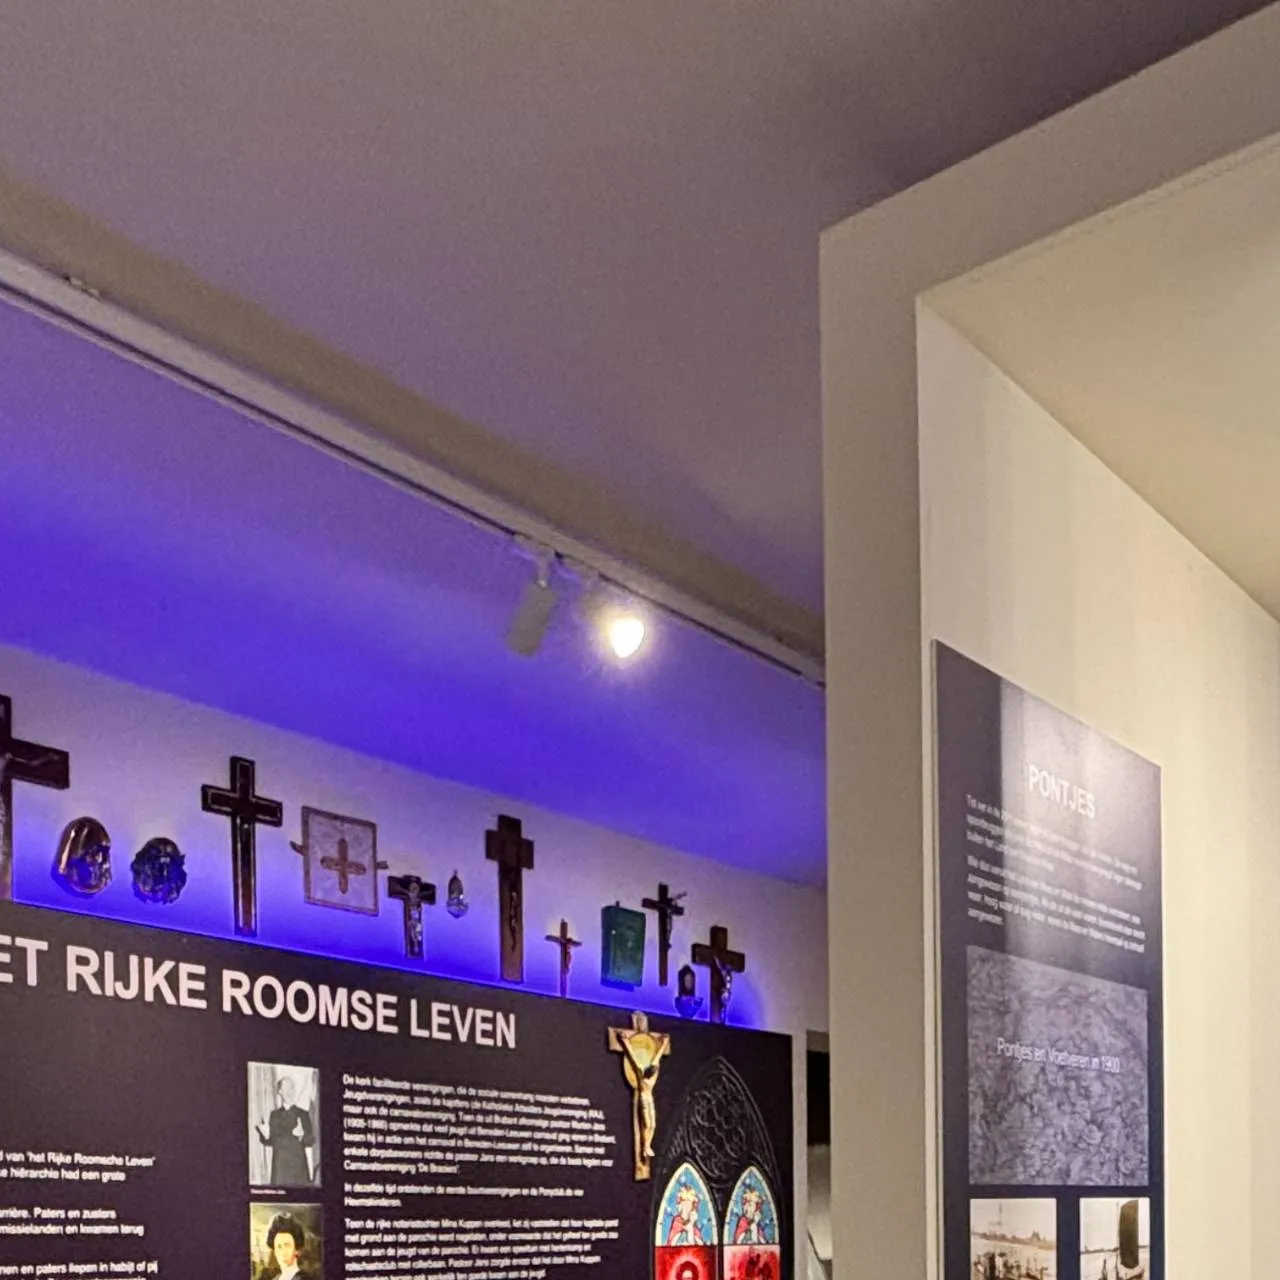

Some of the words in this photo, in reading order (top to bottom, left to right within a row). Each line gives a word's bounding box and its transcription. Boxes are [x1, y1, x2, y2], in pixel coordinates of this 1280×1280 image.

[1027, 764, 1096, 819] PONTJES
[66, 944, 207, 1008] RIJKE
[222, 969, 398, 1034] ROOMSE
[410, 998, 516, 1048] LEVEN
